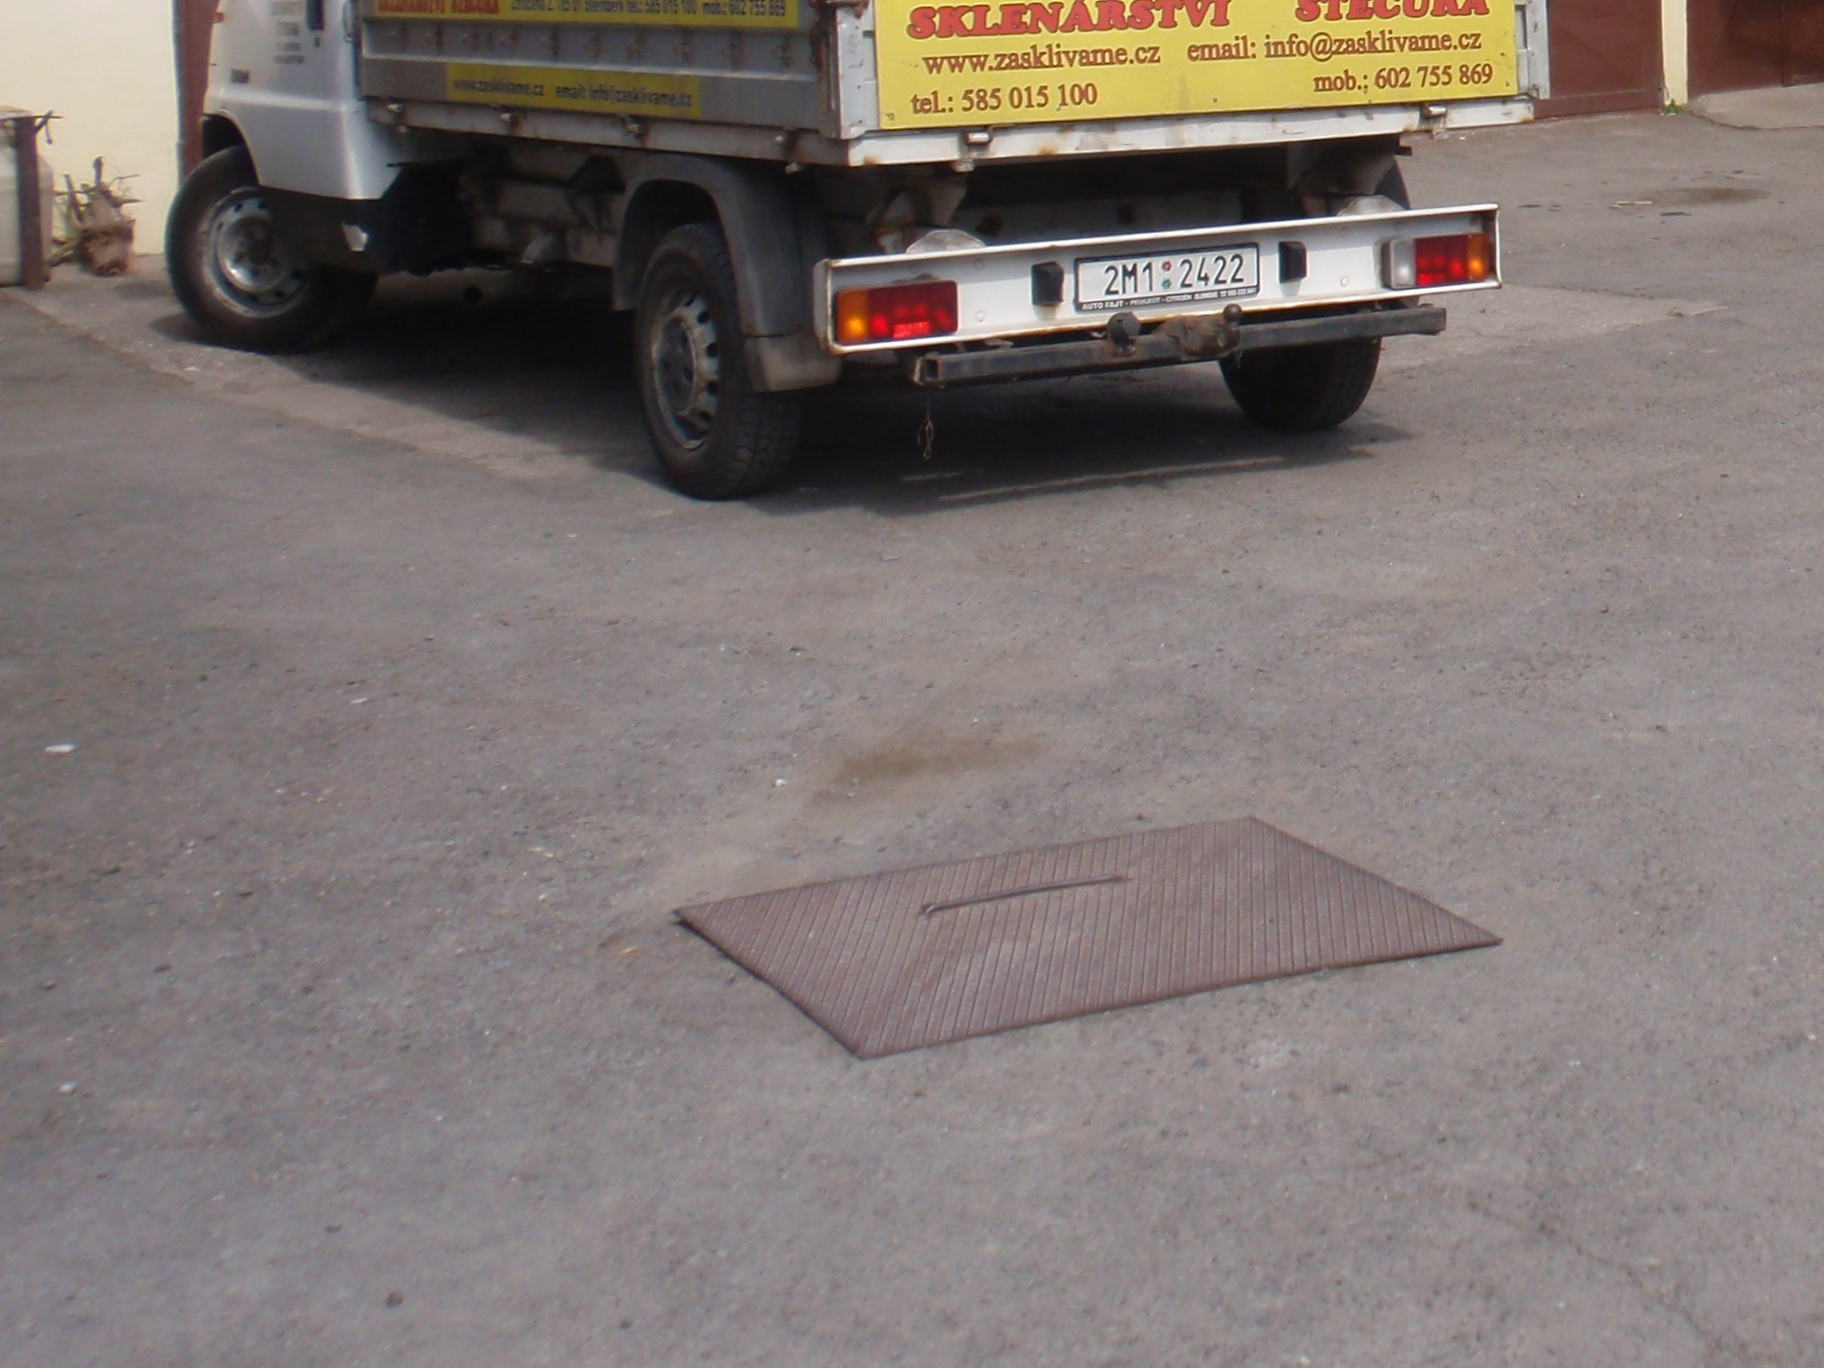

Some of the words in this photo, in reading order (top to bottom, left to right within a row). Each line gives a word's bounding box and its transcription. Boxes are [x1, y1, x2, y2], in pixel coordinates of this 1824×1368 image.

[922, 43, 1161, 74] www.zasklivame.cz
[1187, 35, 1257, 61] email:
[1264, 29, 1482, 62] info@zasklivame.cz
[1313, 69, 1368, 93] mob.:
[1375, 66, 1411, 89] 602
[1416, 65, 1453, 87] 755
[1459, 63, 1494, 85] 869
[911, 90, 954, 114] tel.:
[961, 88, 1002, 112] 585
[1009, 85, 1049, 109] 015
[1058, 83, 1098, 107] 100
[1104, 261, 1153, 296] 2M1
[1179, 253, 1245, 288] 2422
[1082, 301, 1104, 310] AUTO
